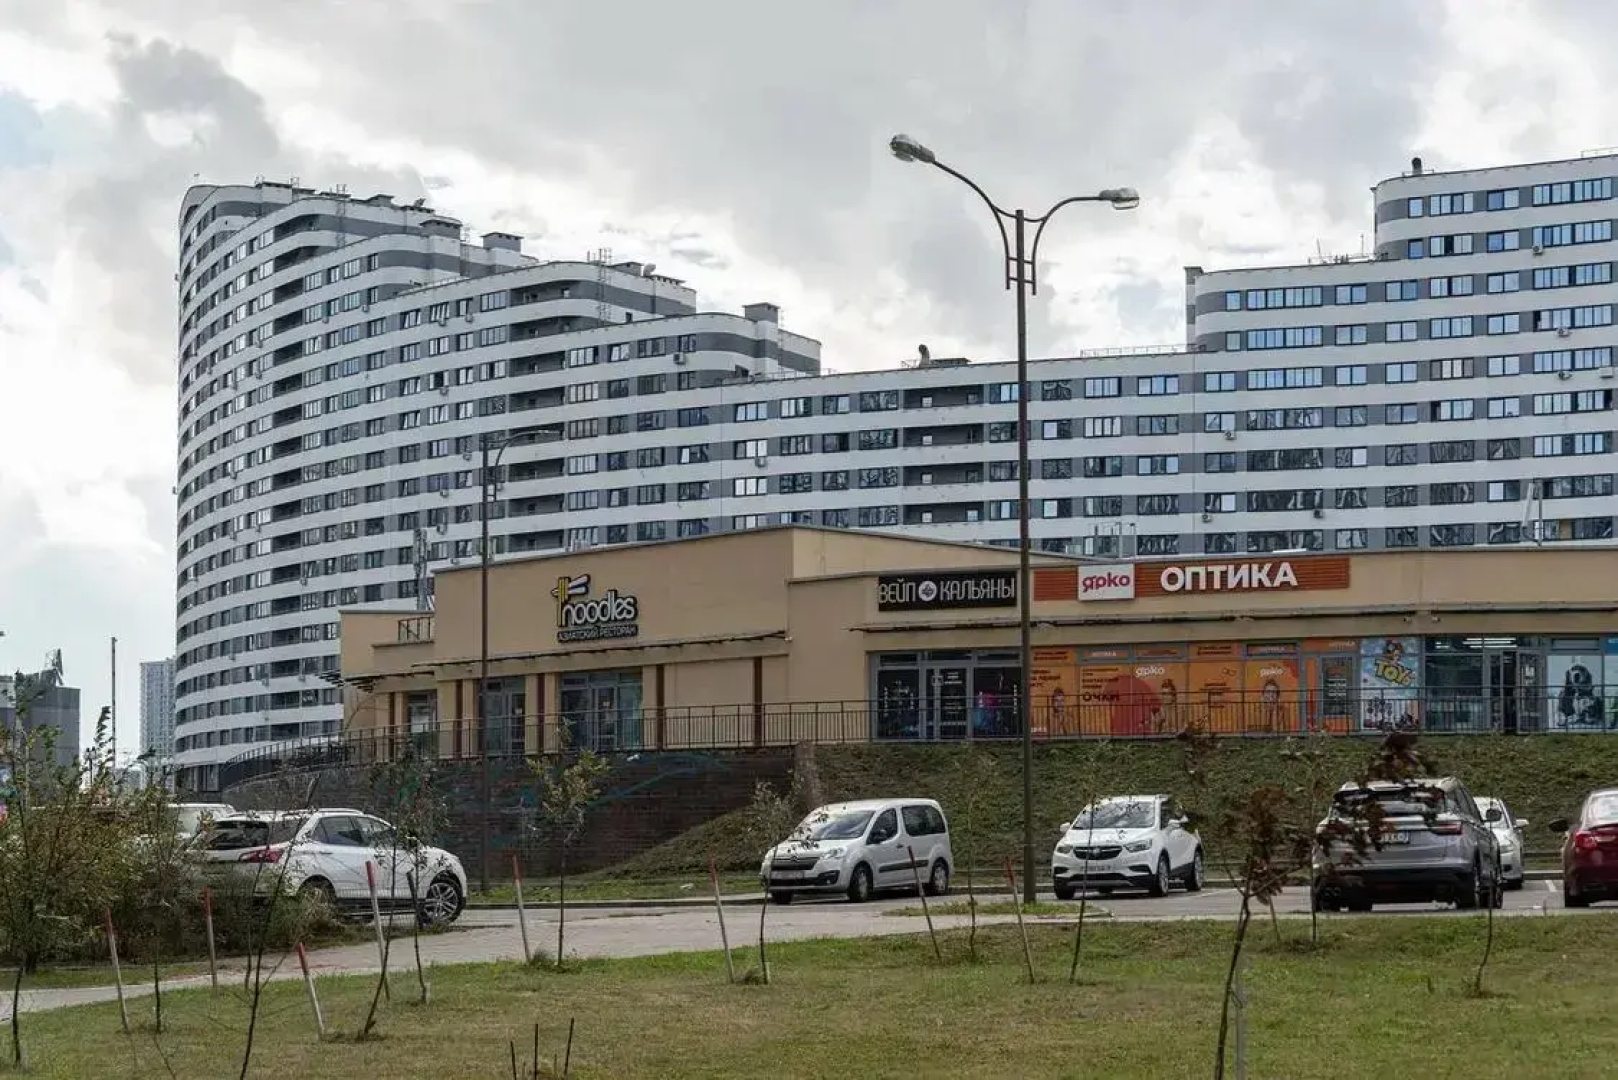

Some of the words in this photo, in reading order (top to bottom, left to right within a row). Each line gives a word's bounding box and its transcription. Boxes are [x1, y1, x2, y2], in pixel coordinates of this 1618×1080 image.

[879, 578, 916, 603] ВЕЙП
[940, 578, 1015, 601] КАЛЬЯНЫ
[1082, 572, 1130, 592] ярко
[1160, 562, 1298, 592] ОПТИКА
[557, 588, 636, 627] noodles
